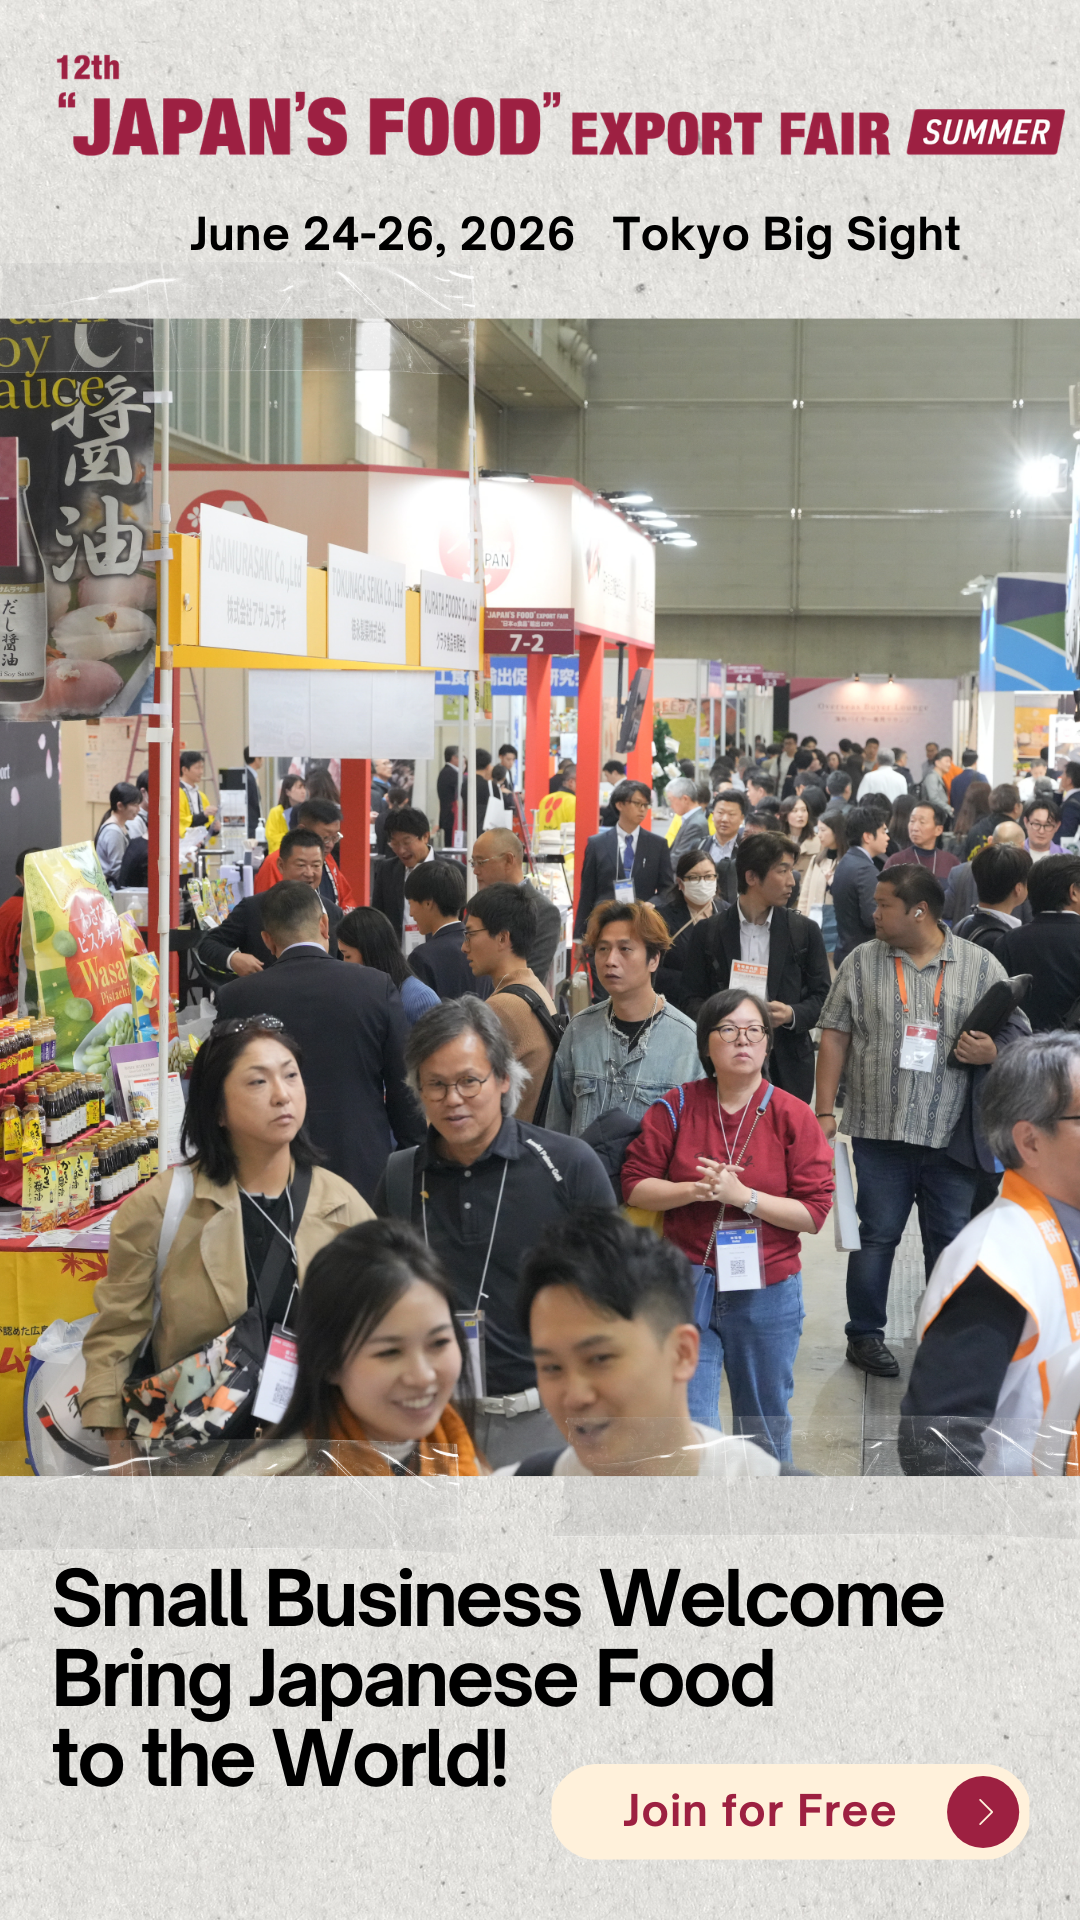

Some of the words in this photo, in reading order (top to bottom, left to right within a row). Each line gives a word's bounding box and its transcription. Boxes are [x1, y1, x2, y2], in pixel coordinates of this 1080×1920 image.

[208, 534, 273, 582] ASAMURASAKI
[483, 552, 509, 567] PAN
[332, 567, 366, 602] TOKUNAGA
[227, 594, 287, 630] 株式会社アサムラサキ
[2, 599, 19, 667] だし醤油
[509, 633, 544, 653] 7-2
[0, 1325, 48, 1336] 認めた広
